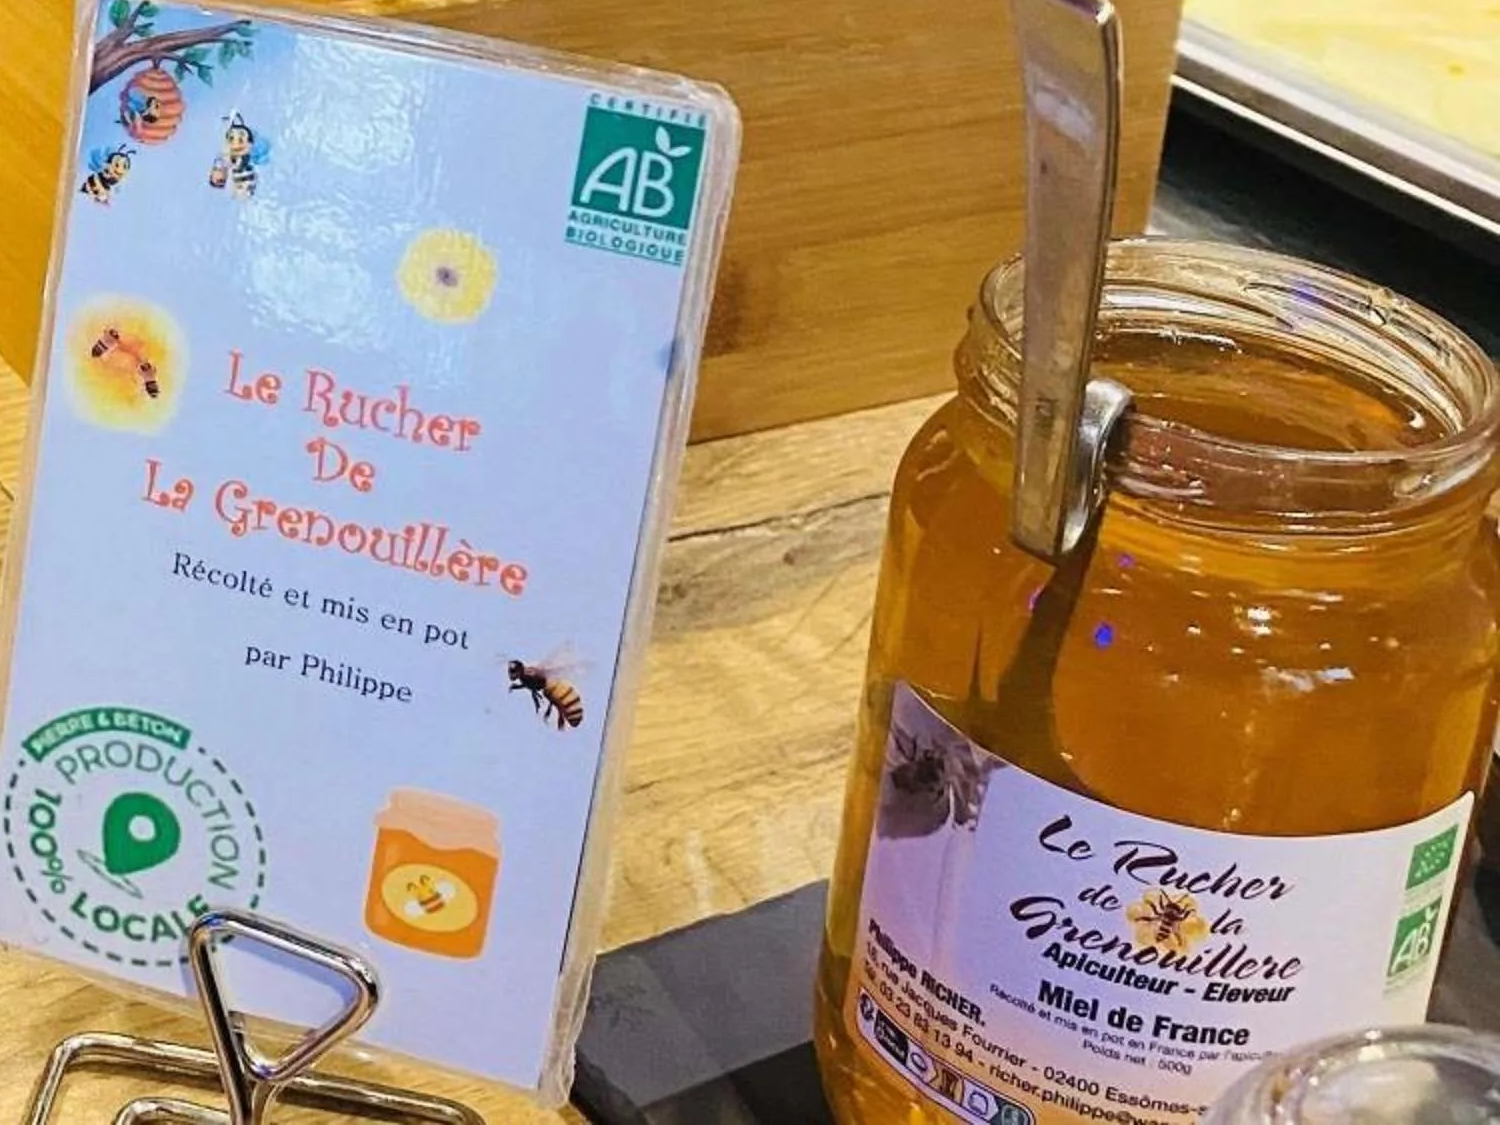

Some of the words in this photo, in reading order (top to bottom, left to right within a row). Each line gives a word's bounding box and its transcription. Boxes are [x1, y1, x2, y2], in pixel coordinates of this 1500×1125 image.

[579, 146, 676, 218] AB
[565, 226, 685, 262] BIOLOGIQUE
[567, 209, 689, 246] AGRICULTURE
[223, 348, 284, 405] Le
[303, 369, 482, 452] Rucher
[305, 436, 377, 493] De
[141, 458, 195, 511] La
[214, 479, 529, 597] Grenouillère
[173, 551, 273, 599] Récolté
[283, 584, 311, 610] et
[321, 597, 370, 624] mis
[381, 614, 415, 636] en
[424, 623, 470, 651] pot
[244, 645, 291, 671] par
[300, 653, 414, 704] Philippe
[28, 787, 74, 894] 100%
[54, 739, 241, 890] PRODUCTION
[1038, 814, 1097, 861] Le
[1112, 840, 1295, 902] Rucher
[1009, 895, 1303, 980] Grenouillere
[1077, 884, 1123, 912] de
[1209, 908, 1247, 936] la
[867, 917, 917, 980] Philippe
[920, 969, 986, 1028] RICHER.
[1042, 941, 1180, 996] Apiculteur
[1202, 981, 1295, 1004] Eleveur
[1391, 920, 1431, 974] AB
[881, 961, 899, 986] rue
[901, 981, 958, 1032] Jacques
[962, 1023, 1027, 1068] Fourrier
[1043, 1065, 1100, 1096] 02400
[933, 1027, 952, 1049] 13
[954, 1041, 974, 1063] 94
[1037, 978, 1100, 1022] Miel
[1107, 1006, 1144, 1033] de
[1151, 1015, 1251, 1046] France
[1038, 1009, 1051, 1022] et
[1054, 1015, 1078, 1032] mis
[1081, 1026, 1099, 1039] en
[1101, 1031, 1125, 1047] pot
[1127, 1037, 1145, 1051] en
[1149, 1040, 1195, 1059] France
[1082, 1038, 1121, 1061] Poids
[1124, 1053, 1146, 1066] net
[1158, 1059, 1193, 1077] 500g
